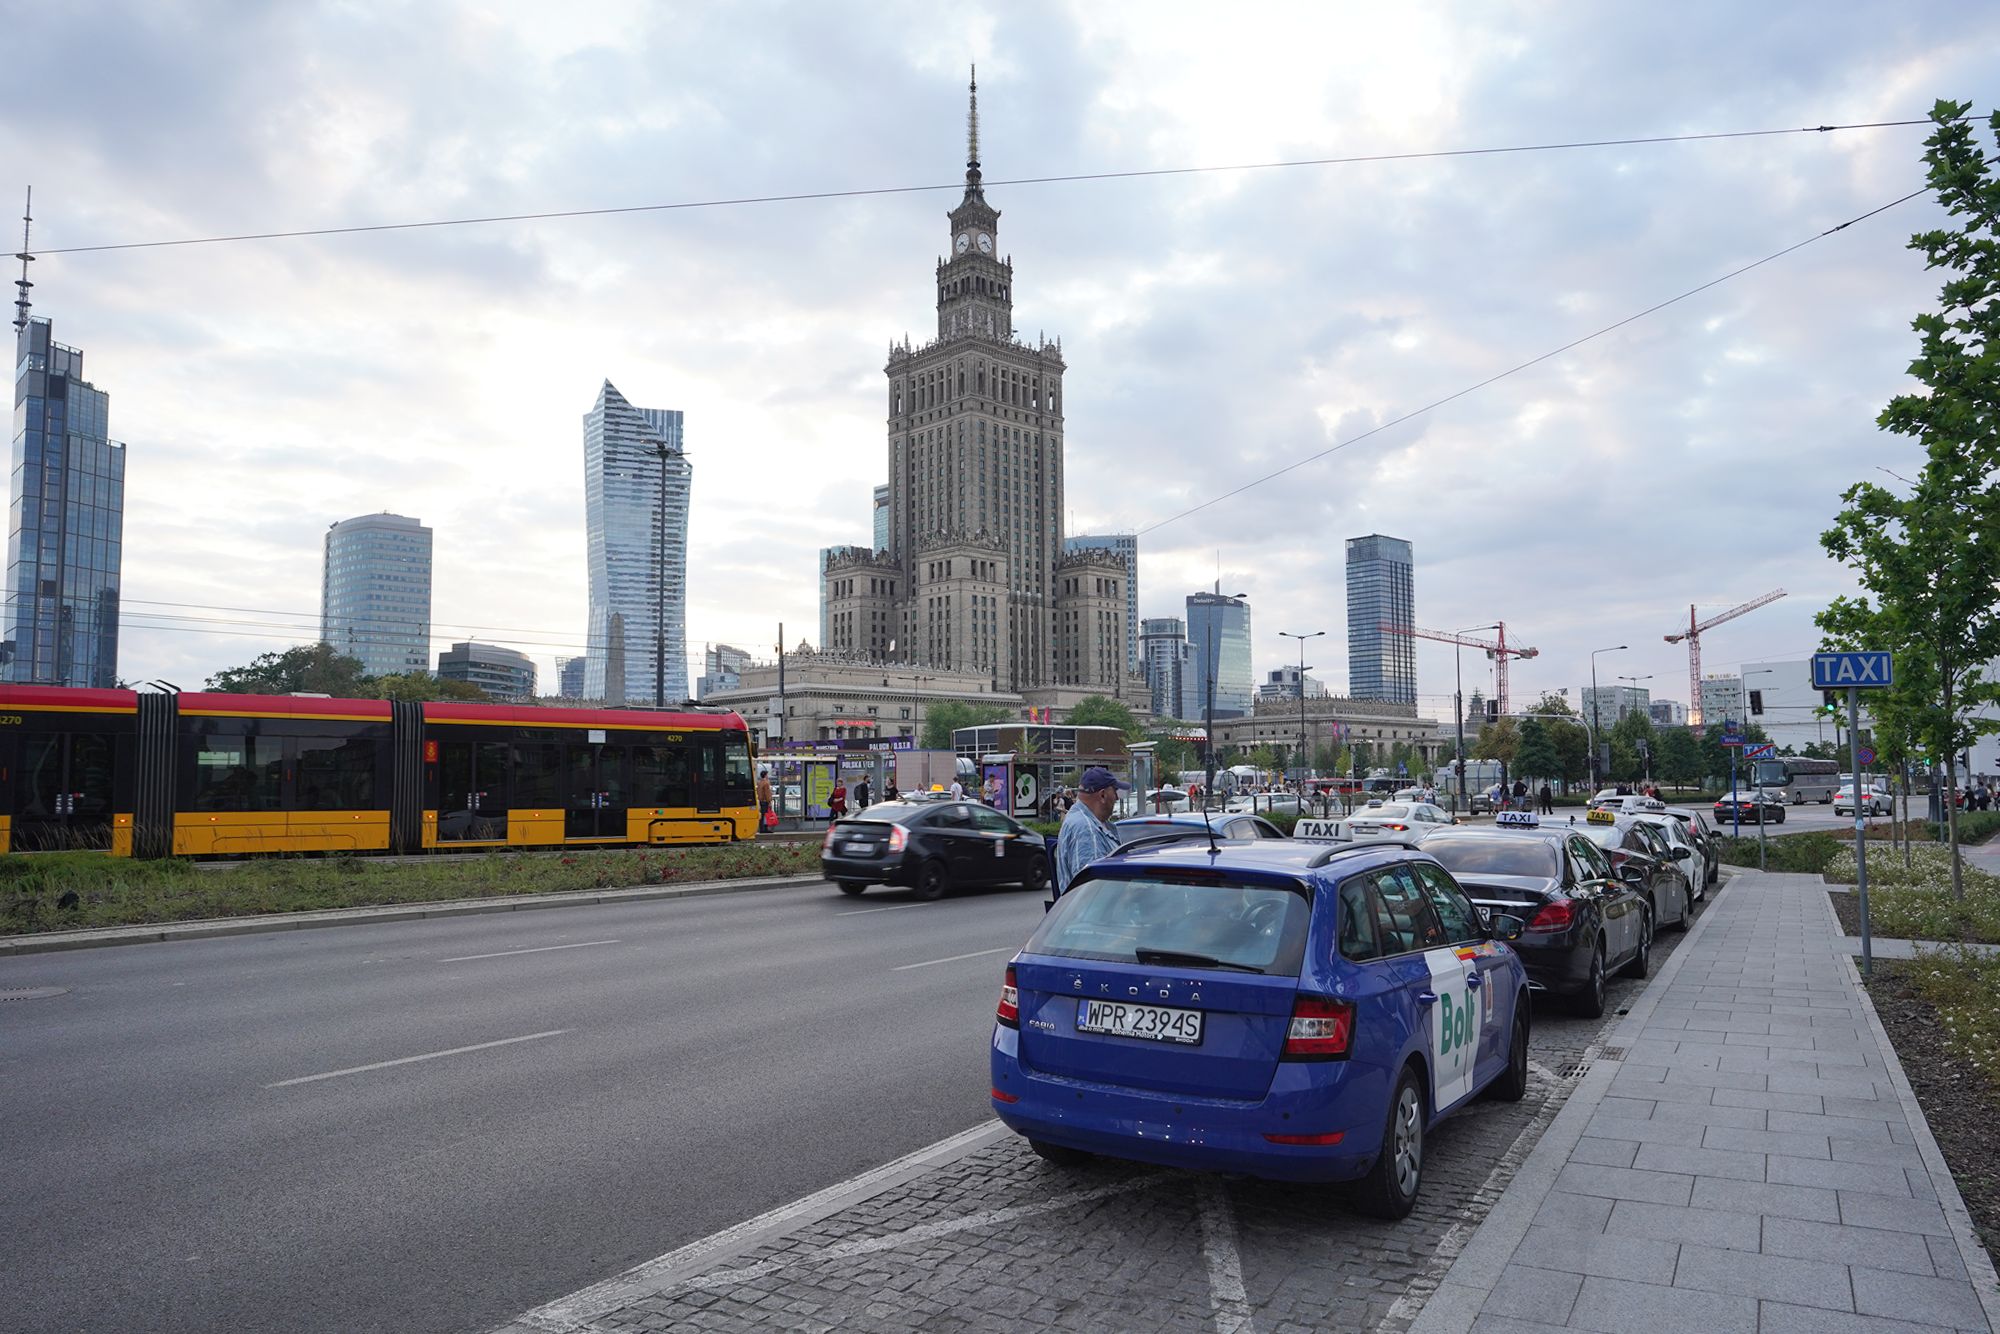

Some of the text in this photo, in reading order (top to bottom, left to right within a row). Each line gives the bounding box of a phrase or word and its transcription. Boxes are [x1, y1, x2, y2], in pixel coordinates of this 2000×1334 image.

[1817, 656, 1889, 682] TAXI
[0, 715, 22, 725] 270
[1745, 745, 1774, 757] TAXI
[841, 761, 862, 769] POLSKA
[1501, 812, 1532, 823] TAXI
[1591, 811, 1610, 820] TAXI
[1303, 823, 1340, 837] TAXI
[1074, 977, 1201, 1001] ŠKODA
[1029, 1020, 1055, 1030] FABIA
[1087, 1002, 1199, 1038] WPR 2394S
[1441, 986, 1475, 1056] Bolt
[1111, 1028, 1156, 1040] Bohemia Motors
